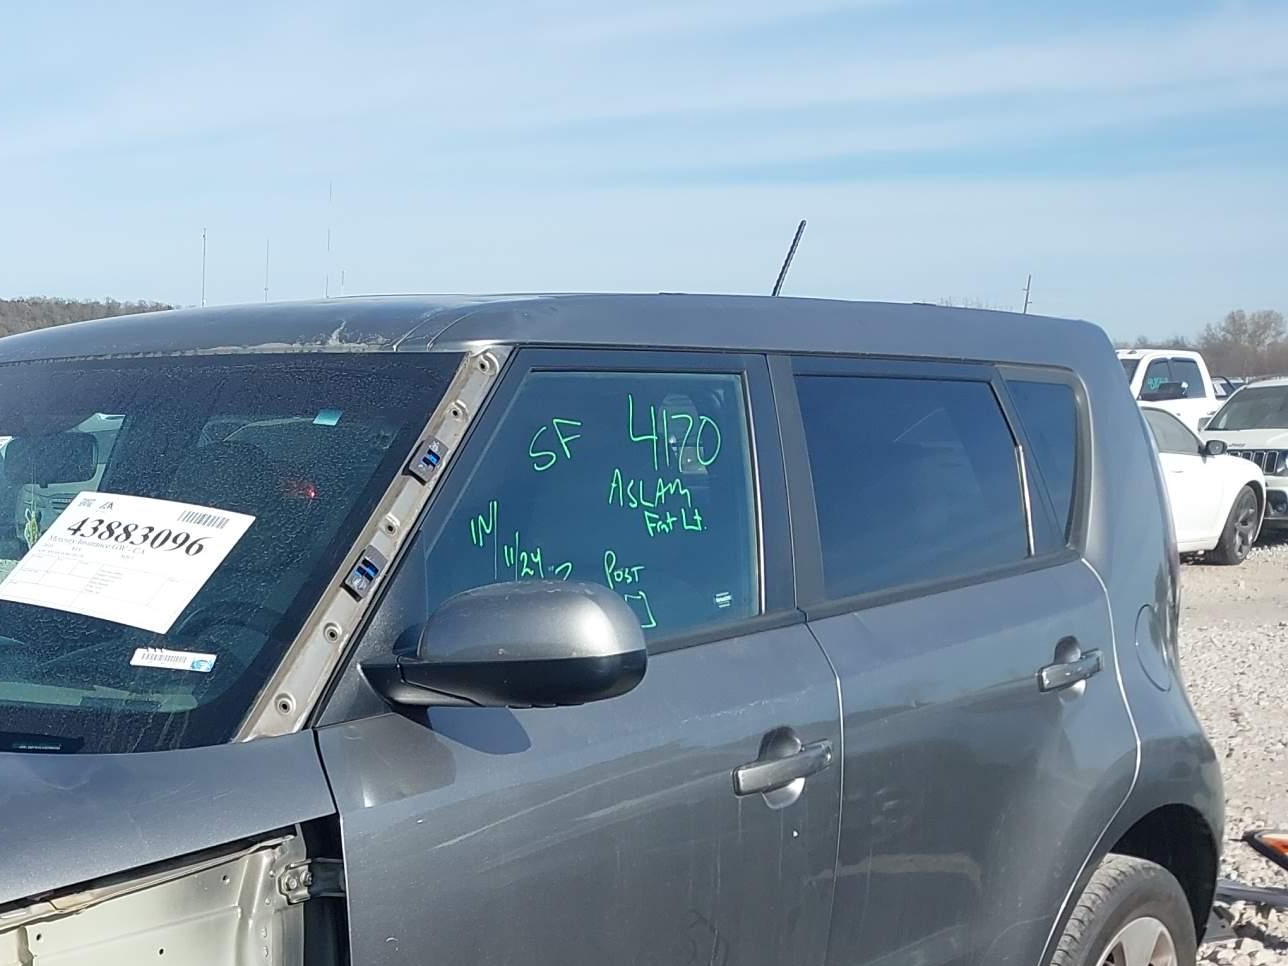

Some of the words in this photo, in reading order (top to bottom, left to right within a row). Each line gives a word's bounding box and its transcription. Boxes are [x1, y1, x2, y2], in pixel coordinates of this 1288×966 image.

[529, 417, 582, 471] SF
[627, 394, 722, 474] 4170
[66, 516, 215, 557] 43883096
